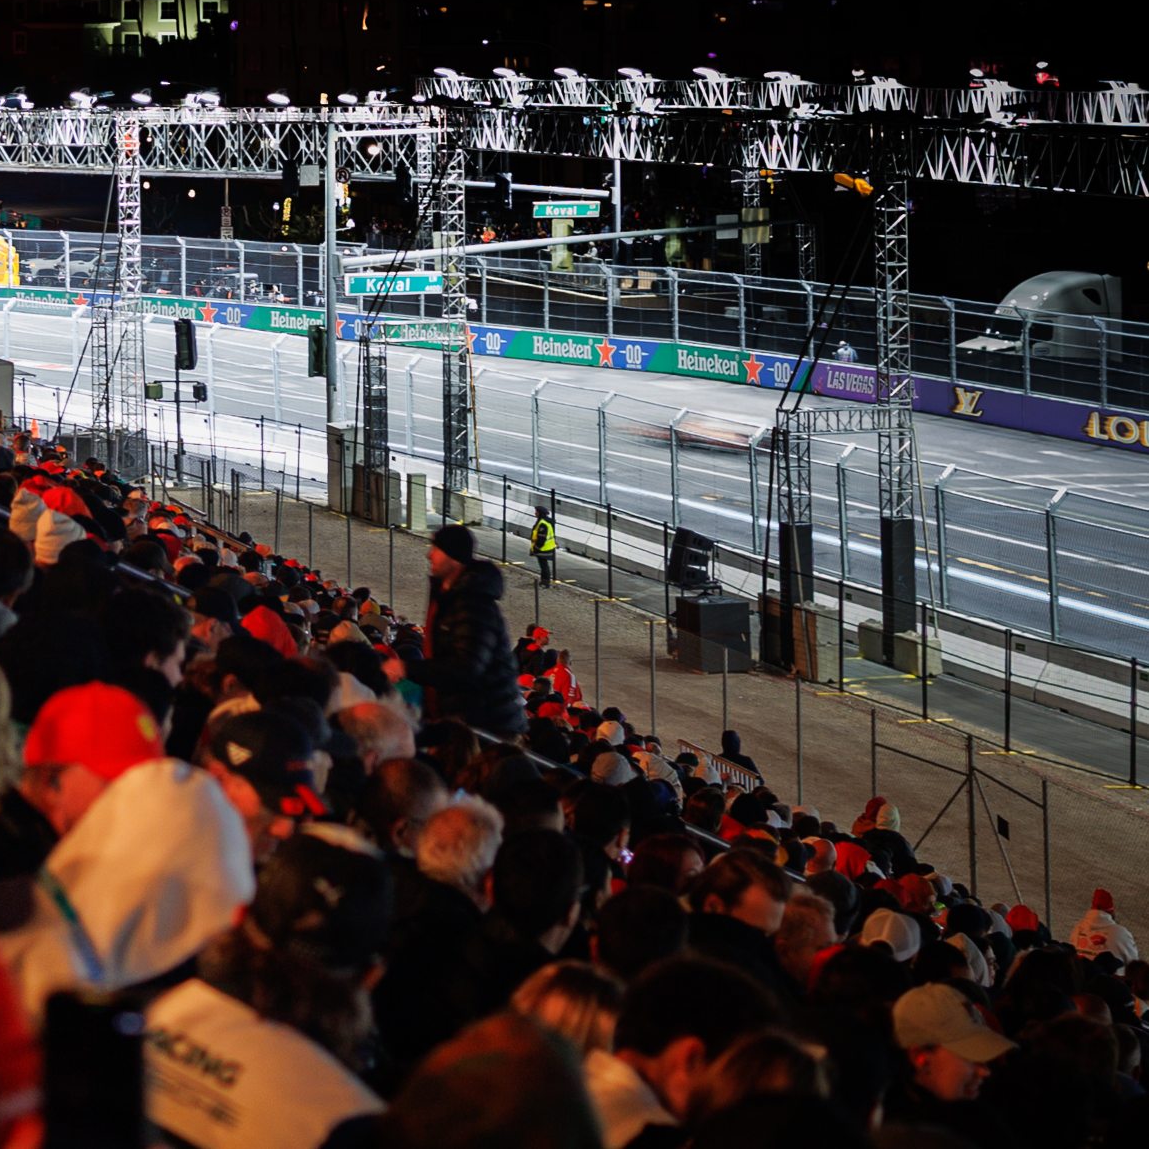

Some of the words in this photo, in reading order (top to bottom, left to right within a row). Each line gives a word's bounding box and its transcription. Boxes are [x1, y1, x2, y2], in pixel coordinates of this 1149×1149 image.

[545, 205, 577, 216] Koval
[366, 278, 410, 292] Koval
[143, 300, 196, 320] Heineken
[532, 335, 593, 360] Heineken
[677, 349, 739, 376] Heineken
[826, 370, 846, 389] LAS
[845, 373, 874, 394] VEGAS
[1087, 411, 1149, 448] LO
